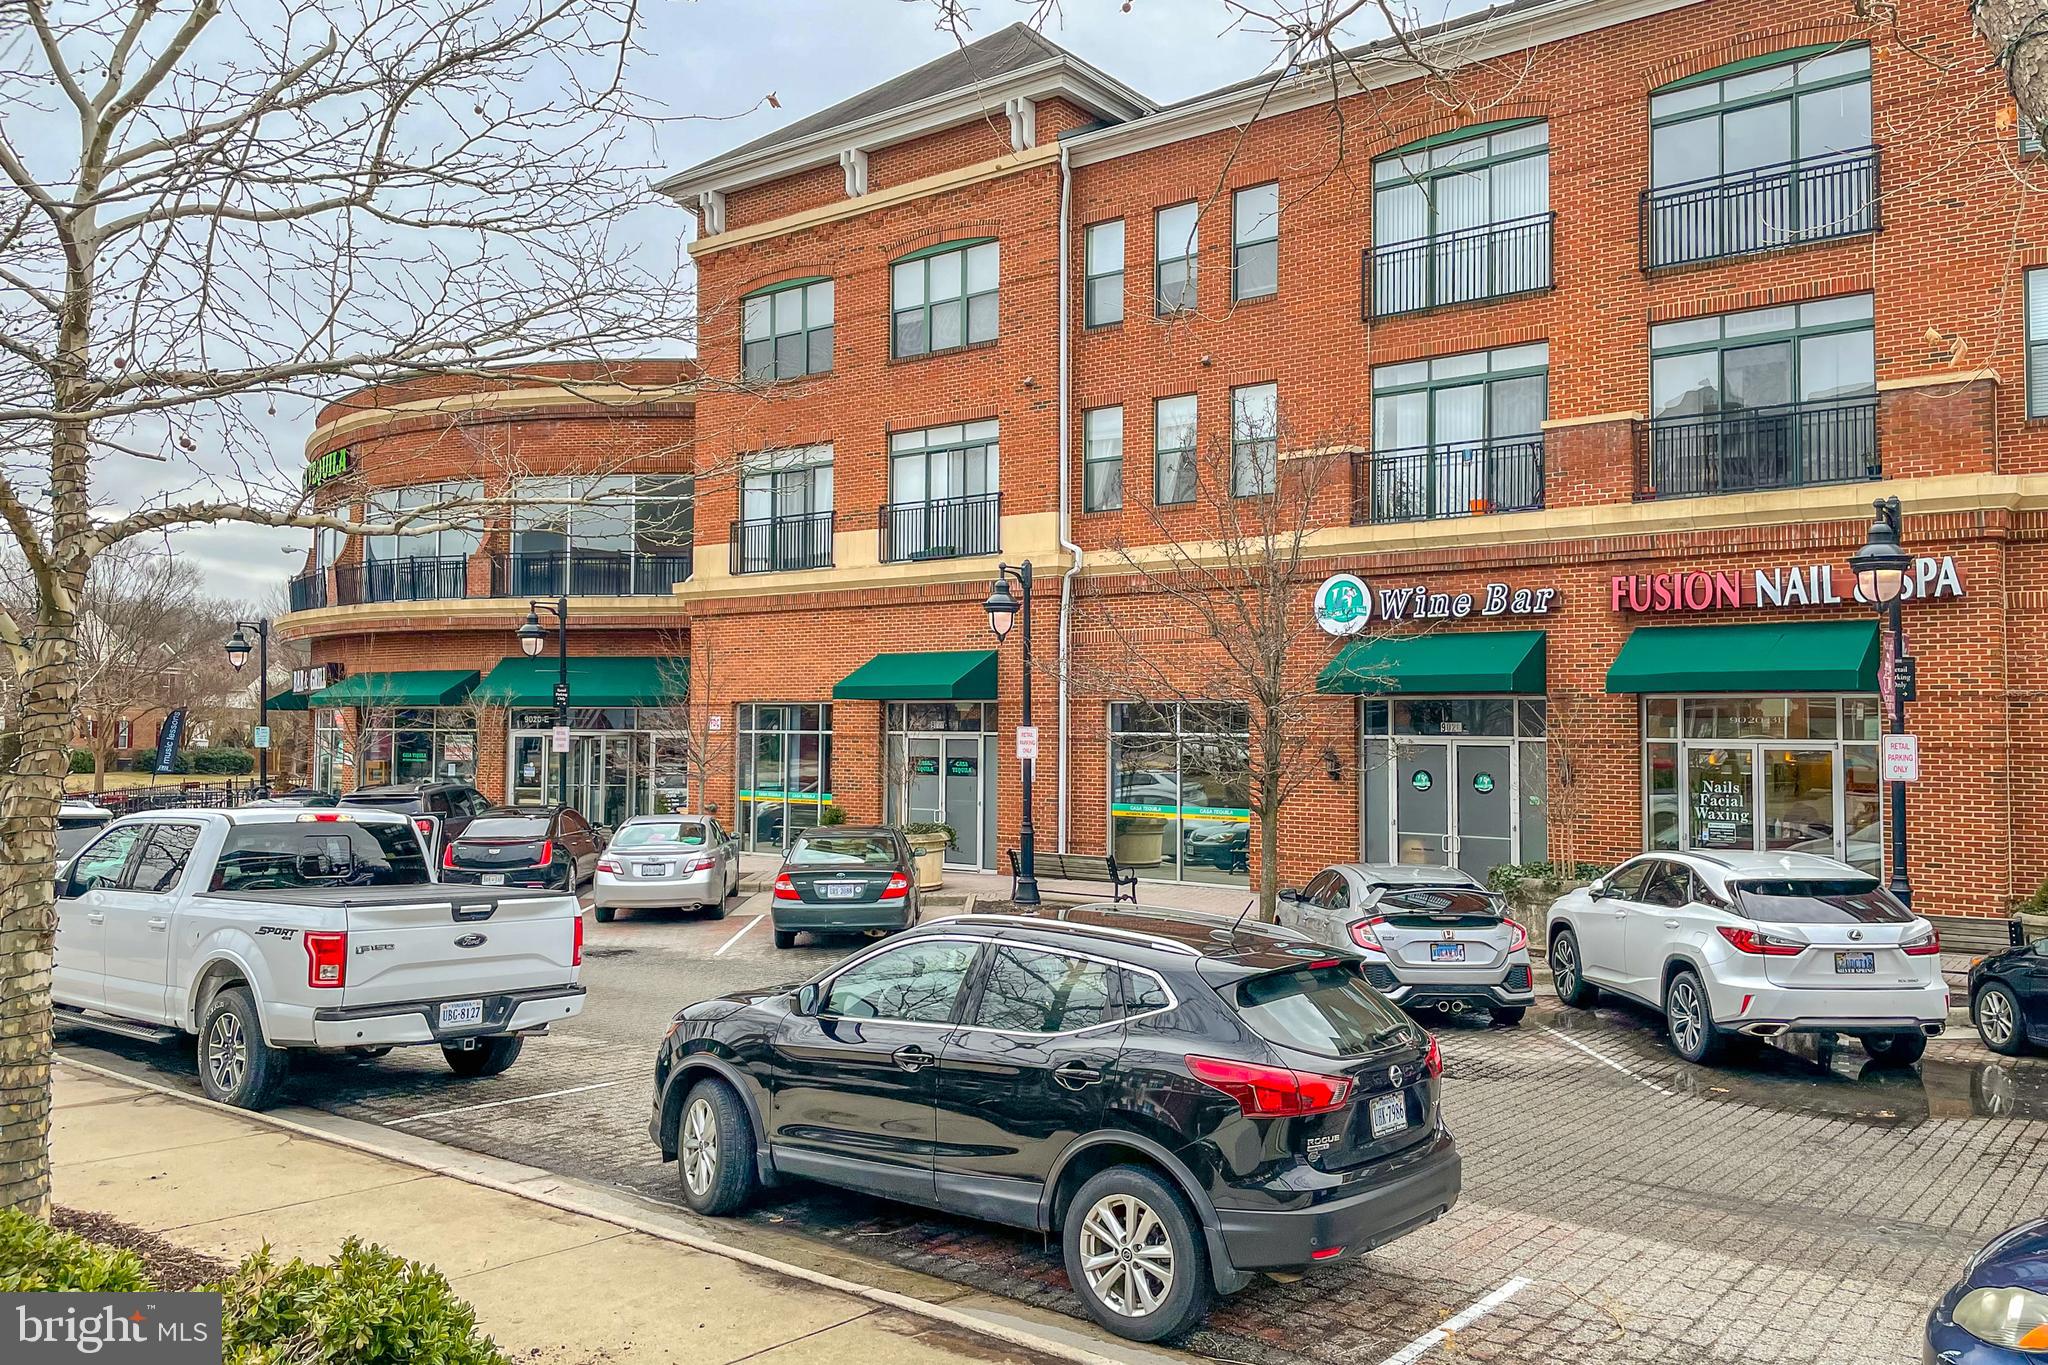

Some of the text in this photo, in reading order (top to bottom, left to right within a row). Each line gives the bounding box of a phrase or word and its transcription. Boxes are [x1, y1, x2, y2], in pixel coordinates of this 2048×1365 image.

[1611, 569, 1742, 613] FUSION
[1754, 564, 1841, 609] NAIL
[1378, 585, 1472, 620] Wine
[1481, 582, 1556, 616] Bar
[166, 711, 181, 740] lessons
[163, 741, 174, 764] music
[1890, 742, 1911, 750] RETAIL
[1887, 753, 1914, 762] PARKING
[1893, 765, 1909, 773] ONLY
[1702, 780, 1740, 794] Nails
[1699, 793, 1744, 807] Facial
[1694, 806, 1750, 824] Waxing
[254, 926, 299, 937] SPORT
[1307, 1134, 1341, 1146] ROGUE
